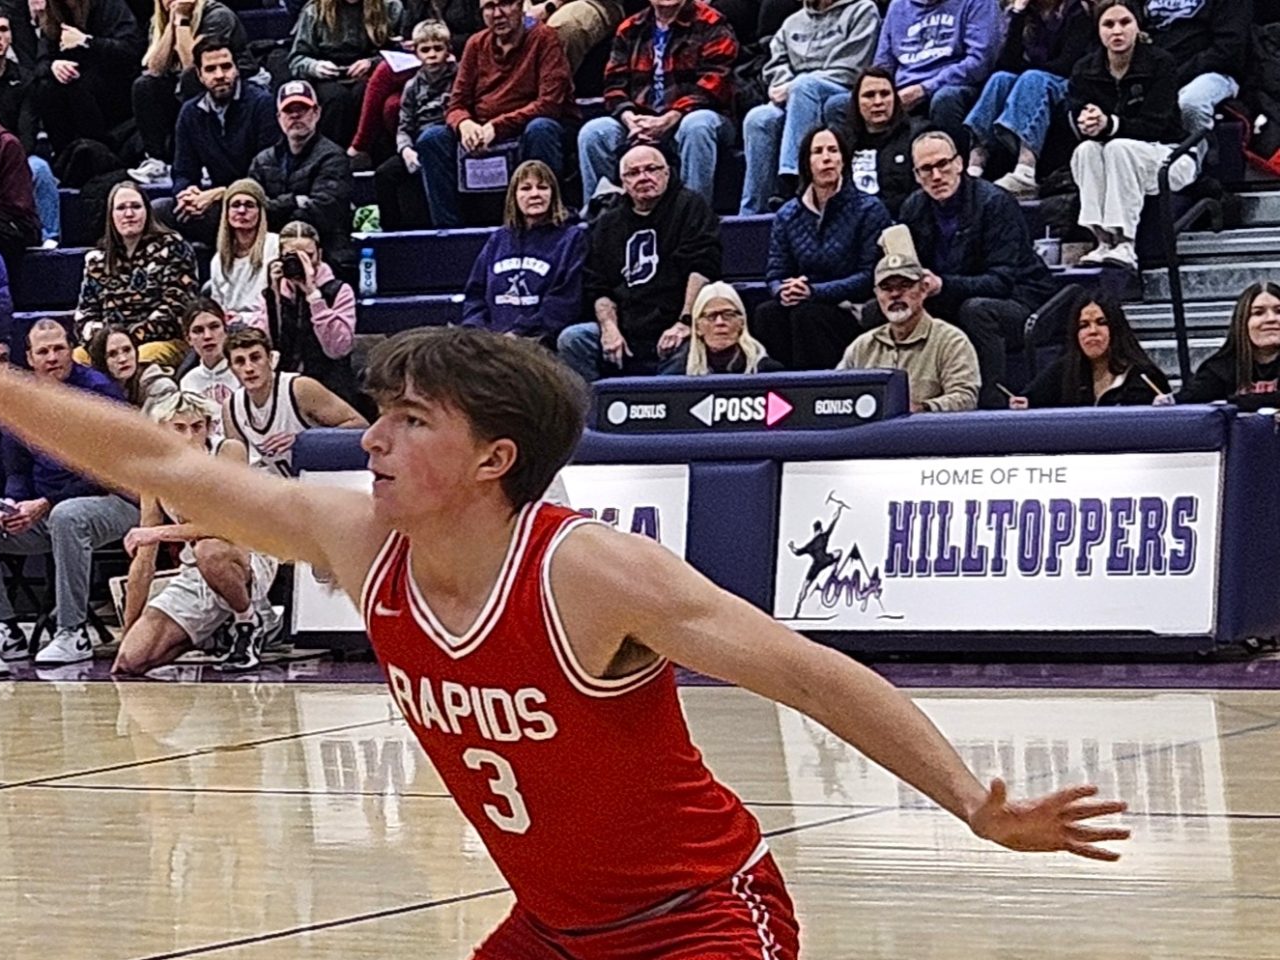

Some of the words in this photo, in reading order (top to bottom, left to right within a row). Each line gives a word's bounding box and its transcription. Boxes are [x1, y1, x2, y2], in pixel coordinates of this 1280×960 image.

[630, 404, 666, 419] BONUS
[713, 397, 766, 421] POSS
[815, 399, 853, 414] BONUS
[920, 469, 983, 486] HOME
[990, 468, 1018, 485] OF
[1026, 466, 1068, 485] THE
[884, 496, 1199, 577] HILLTOPPERS
[387, 662, 558, 742] RAPIDS
[462, 747, 531, 835] 3
